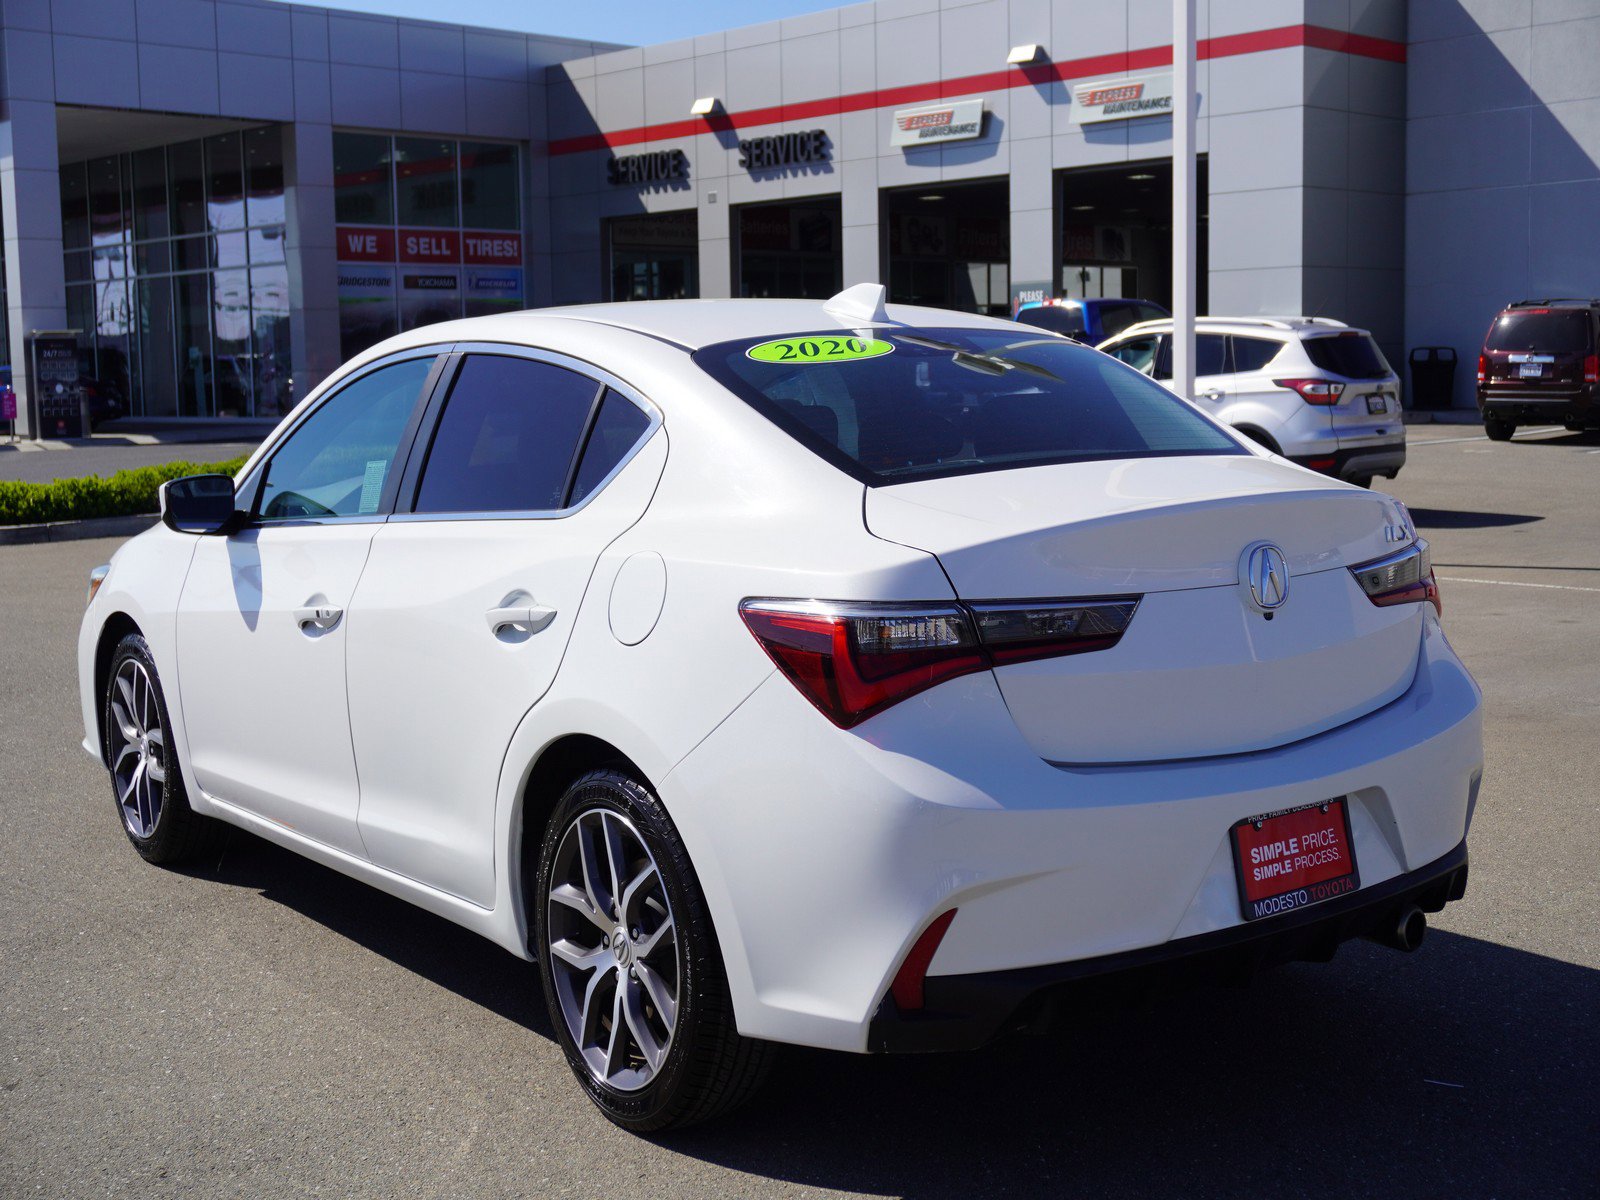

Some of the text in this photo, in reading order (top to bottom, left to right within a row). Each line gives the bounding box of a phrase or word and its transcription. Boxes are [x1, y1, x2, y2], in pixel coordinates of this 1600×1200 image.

[1095, 87, 1137, 102] EXPRESS
[1103, 96, 1172, 114] MAINTENANCE
[911, 113, 948, 126] EXPRESS
[919, 122, 977, 138] MAINTENANCE
[740, 129, 828, 168] SERVICE
[608, 150, 684, 185] SERVICE
[347, 235, 518, 257] WE SELL TIRES!
[337, 276, 392, 288] BRIDGESTONE
[418, 277, 456, 288] YOKOHAMA
[478, 279, 516, 289] MICHELIN
[1019, 290, 1044, 302] PLEASE
[774, 338, 867, 360] 2020
[1384, 524, 1412, 542] ILX
[1250, 828, 1339, 864] SIMPLE PRICE.
[1253, 847, 1342, 881] SIMPLE PROCESS.
[1254, 878, 1354, 917] MODESTO TOYOTA
